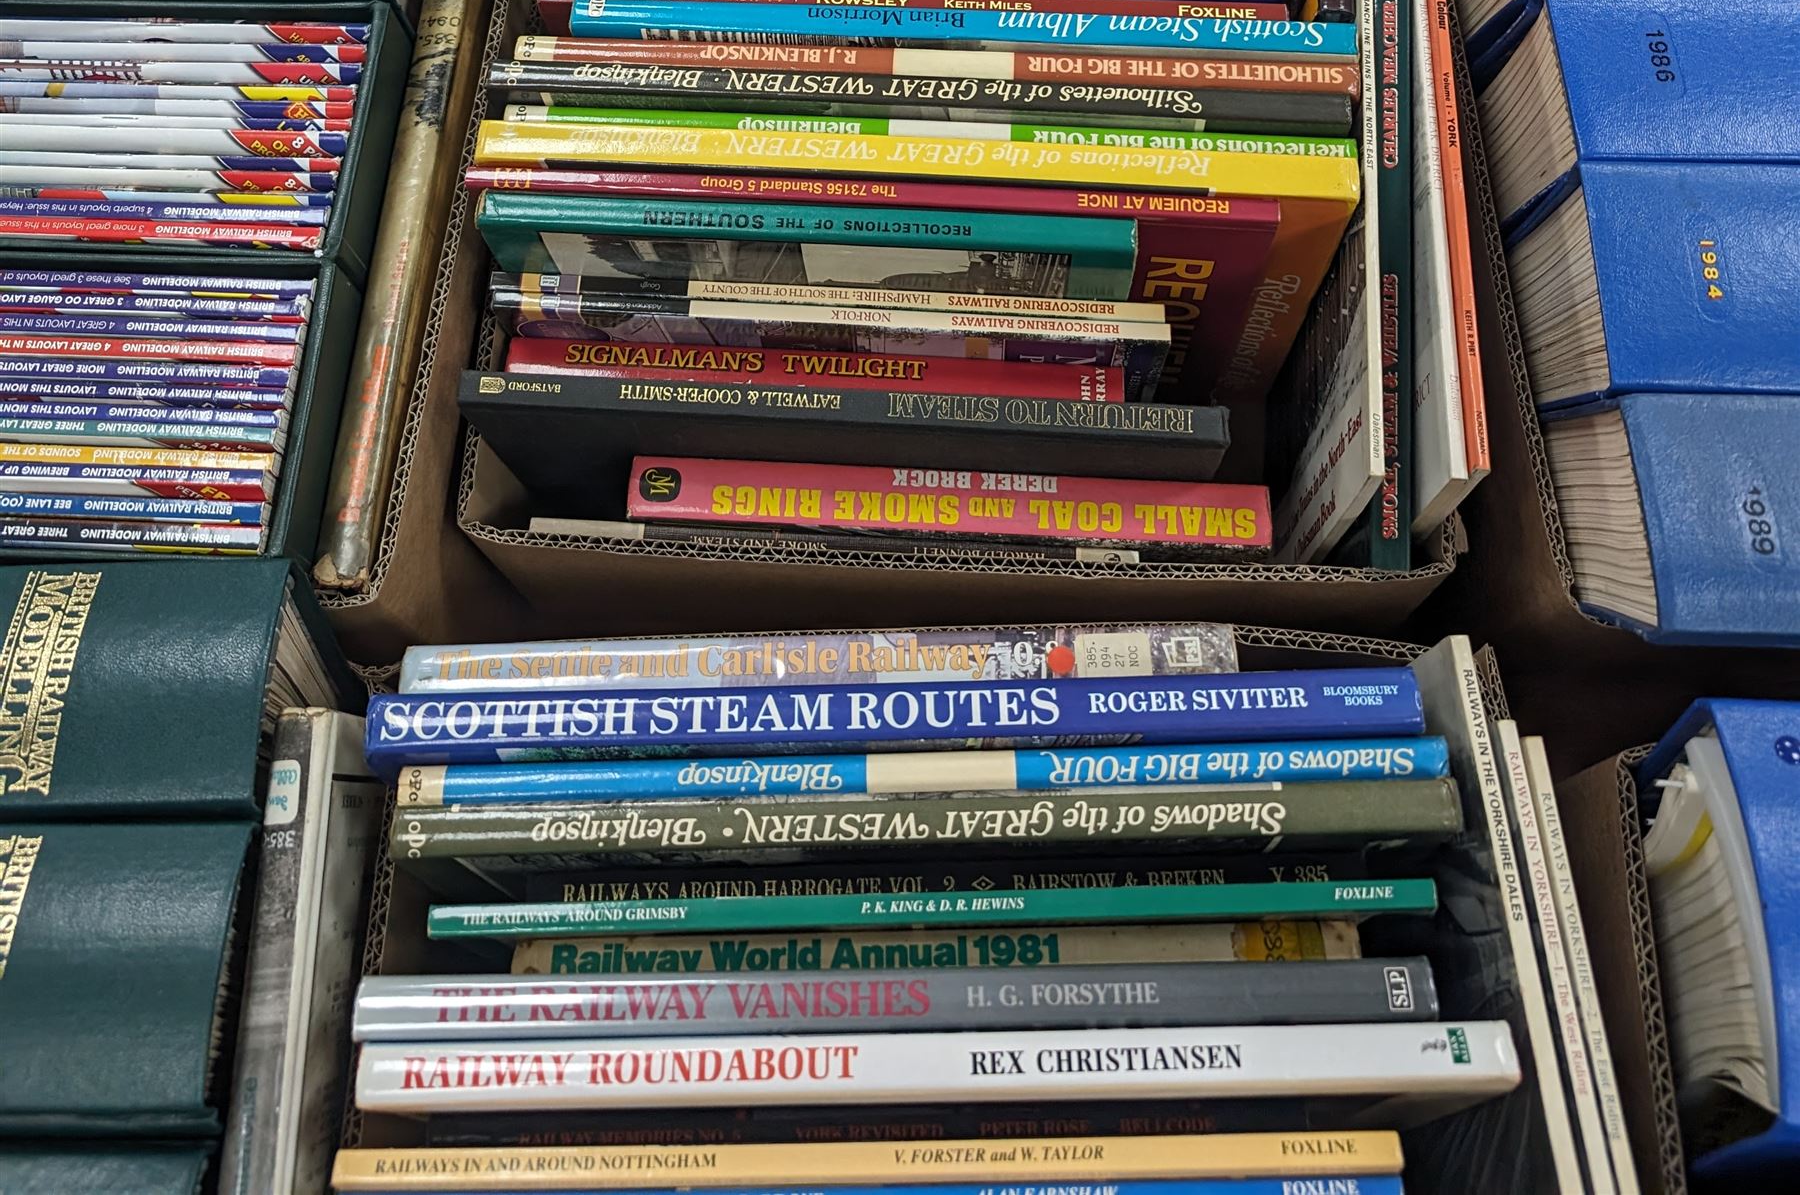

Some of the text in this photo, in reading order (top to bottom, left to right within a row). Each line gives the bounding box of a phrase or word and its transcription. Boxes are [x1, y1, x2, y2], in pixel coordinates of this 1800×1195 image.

[944, 0, 985, 9] KEITH
[989, 0, 1032, 10] MILES
[1178, 5, 1257, 19] FOXLINE
[997, 11, 1327, 46] Scottish Steam Album
[1645, 29, 1675, 83] 1986
[643, 210, 972, 236] RECOLLECTIONS OF THE SOUTHERN
[1700, 240, 1723, 300] 1984
[565, 343, 929, 381] SIGNALMAN'S TWILIGHT
[892, 468, 1058, 493] DEREK BROCK
[26, 497, 233, 515] BRITISH RAILWAY MODELLING BEE LANE
[711, 484, 1256, 539] SMALL COAL AND SMOKE RINGS
[1741, 486, 1775, 556] 1989
[1101, 645, 1112, 668] 094
[1115, 652, 1126, 667] 27
[1129, 644, 1140, 667] NOC
[1323, 685, 1400, 697] BLOOMSBURY
[1344, 695, 1384, 706] BOOKS
[379, 686, 1308, 742] SCOTTISH STEAM ROUTES ROGER SIVITER
[1463, 668, 1525, 923] RAILWAYS IN THE YORKSHIRE DALES
[1334, 887, 1395, 902] FOXLINE
[463, 906, 688, 925] THE RAILWAYS AROUND GRIMSBY
[400, 1044, 1242, 1089] RAILWAY ROUNDABOUT REX CHRISTIANSEN
